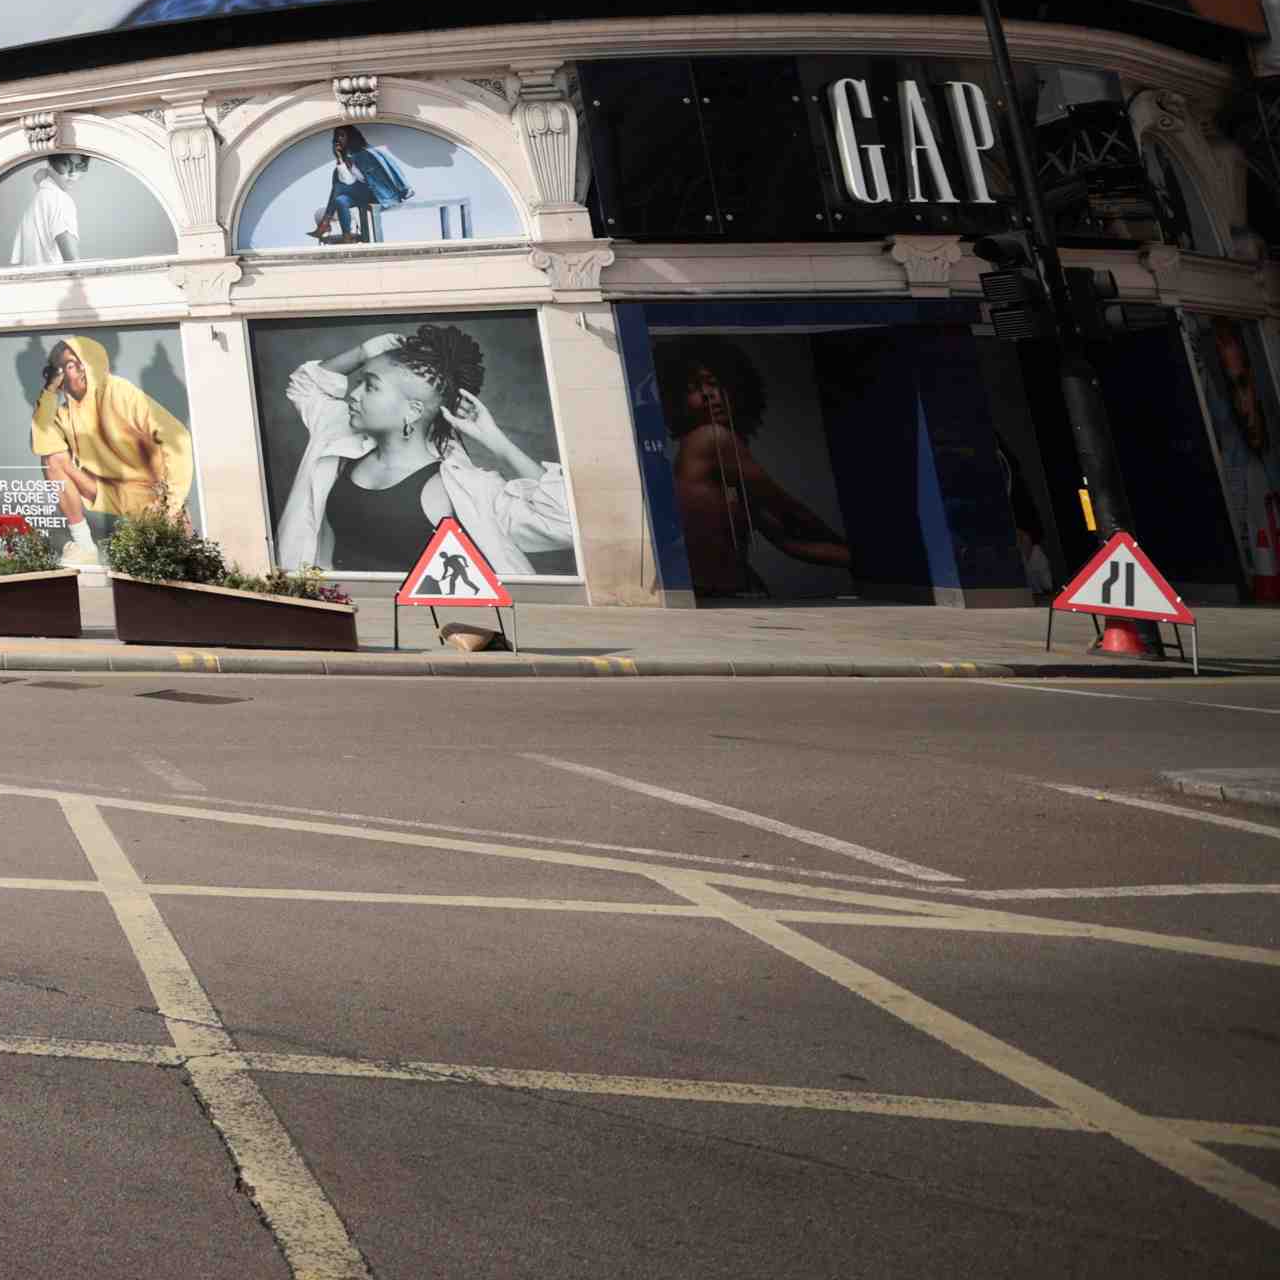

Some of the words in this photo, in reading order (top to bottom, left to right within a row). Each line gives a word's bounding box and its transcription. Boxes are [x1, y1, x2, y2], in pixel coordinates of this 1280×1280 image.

[828, 77, 998, 204] GAP
[11, 480, 65, 492] CLOSEST
[3, 492, 45, 503] STORE
[47, 492, 60, 504] IS
[2, 505, 56, 516] FLAGSHIP
[25, 517, 67, 528] STREET
